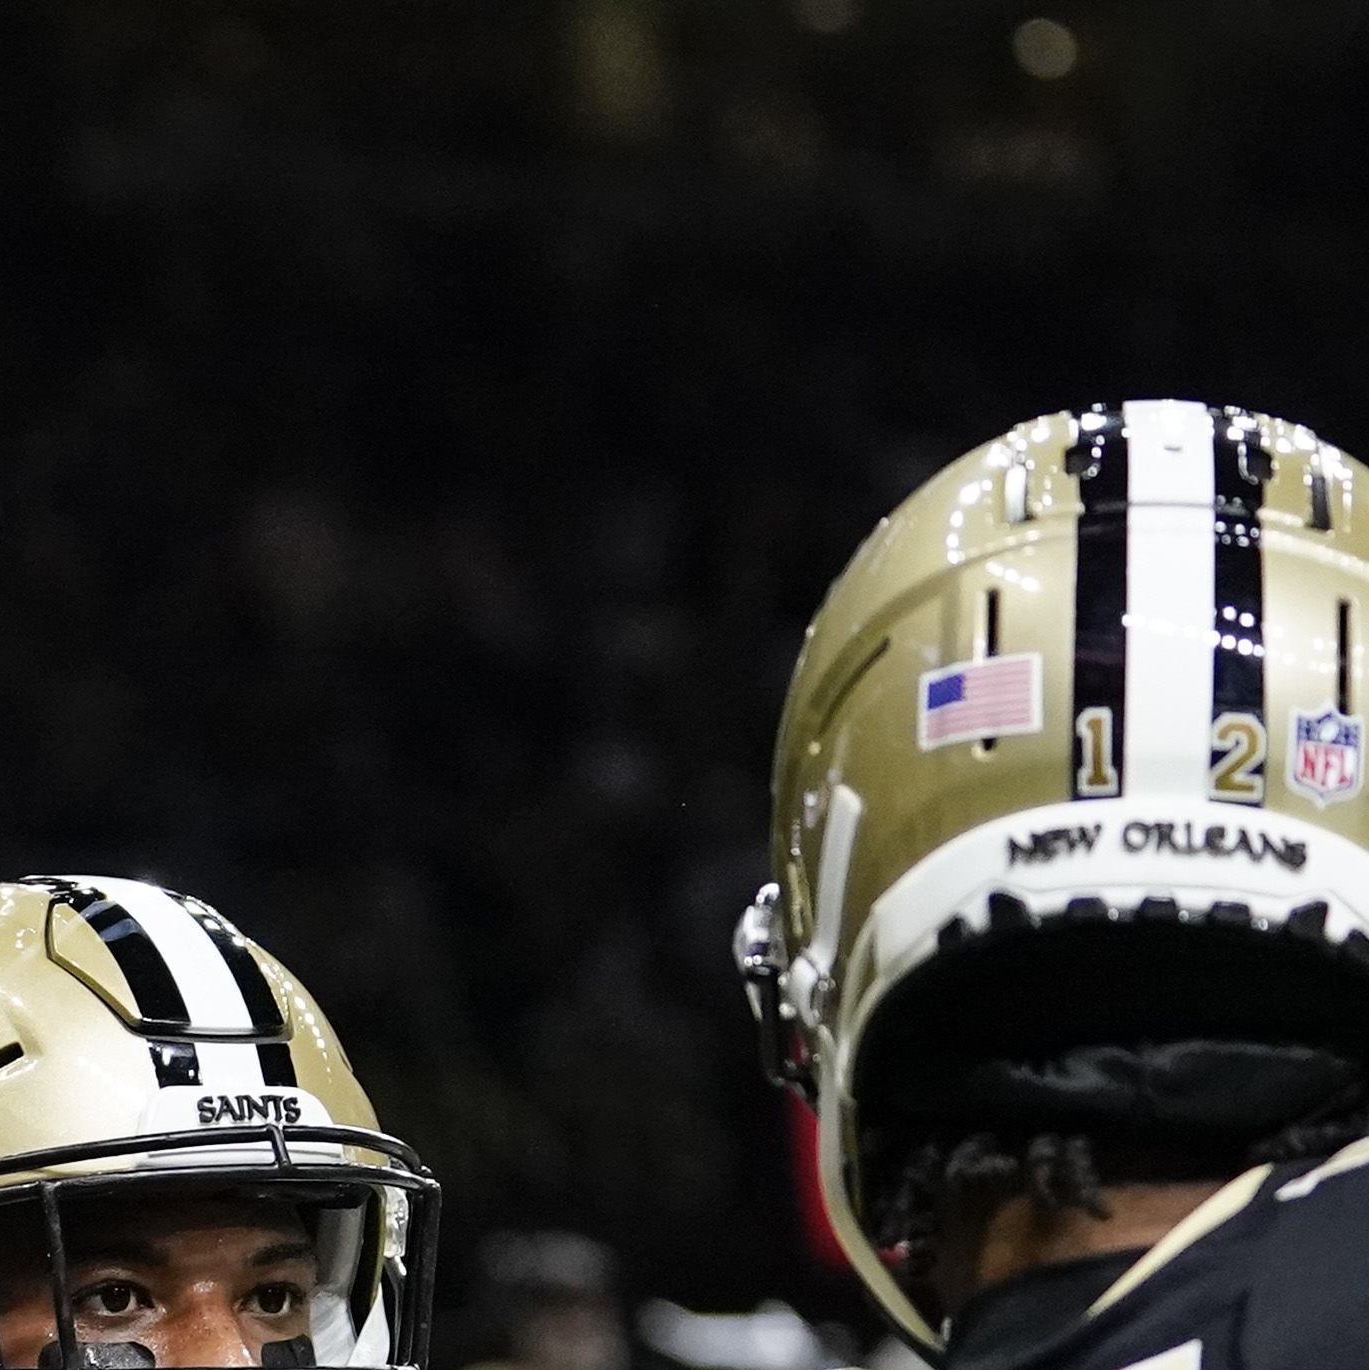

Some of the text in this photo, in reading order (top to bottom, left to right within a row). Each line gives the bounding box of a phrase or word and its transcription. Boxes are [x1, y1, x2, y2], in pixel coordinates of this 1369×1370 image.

[1076, 706, 1118, 796] 1
[1212, 712, 1267, 801] 2
[1298, 748, 1350, 787] NFL
[1008, 820, 1307, 871] NEW ORLEANS
[197, 1094, 301, 1124] SAINTS
